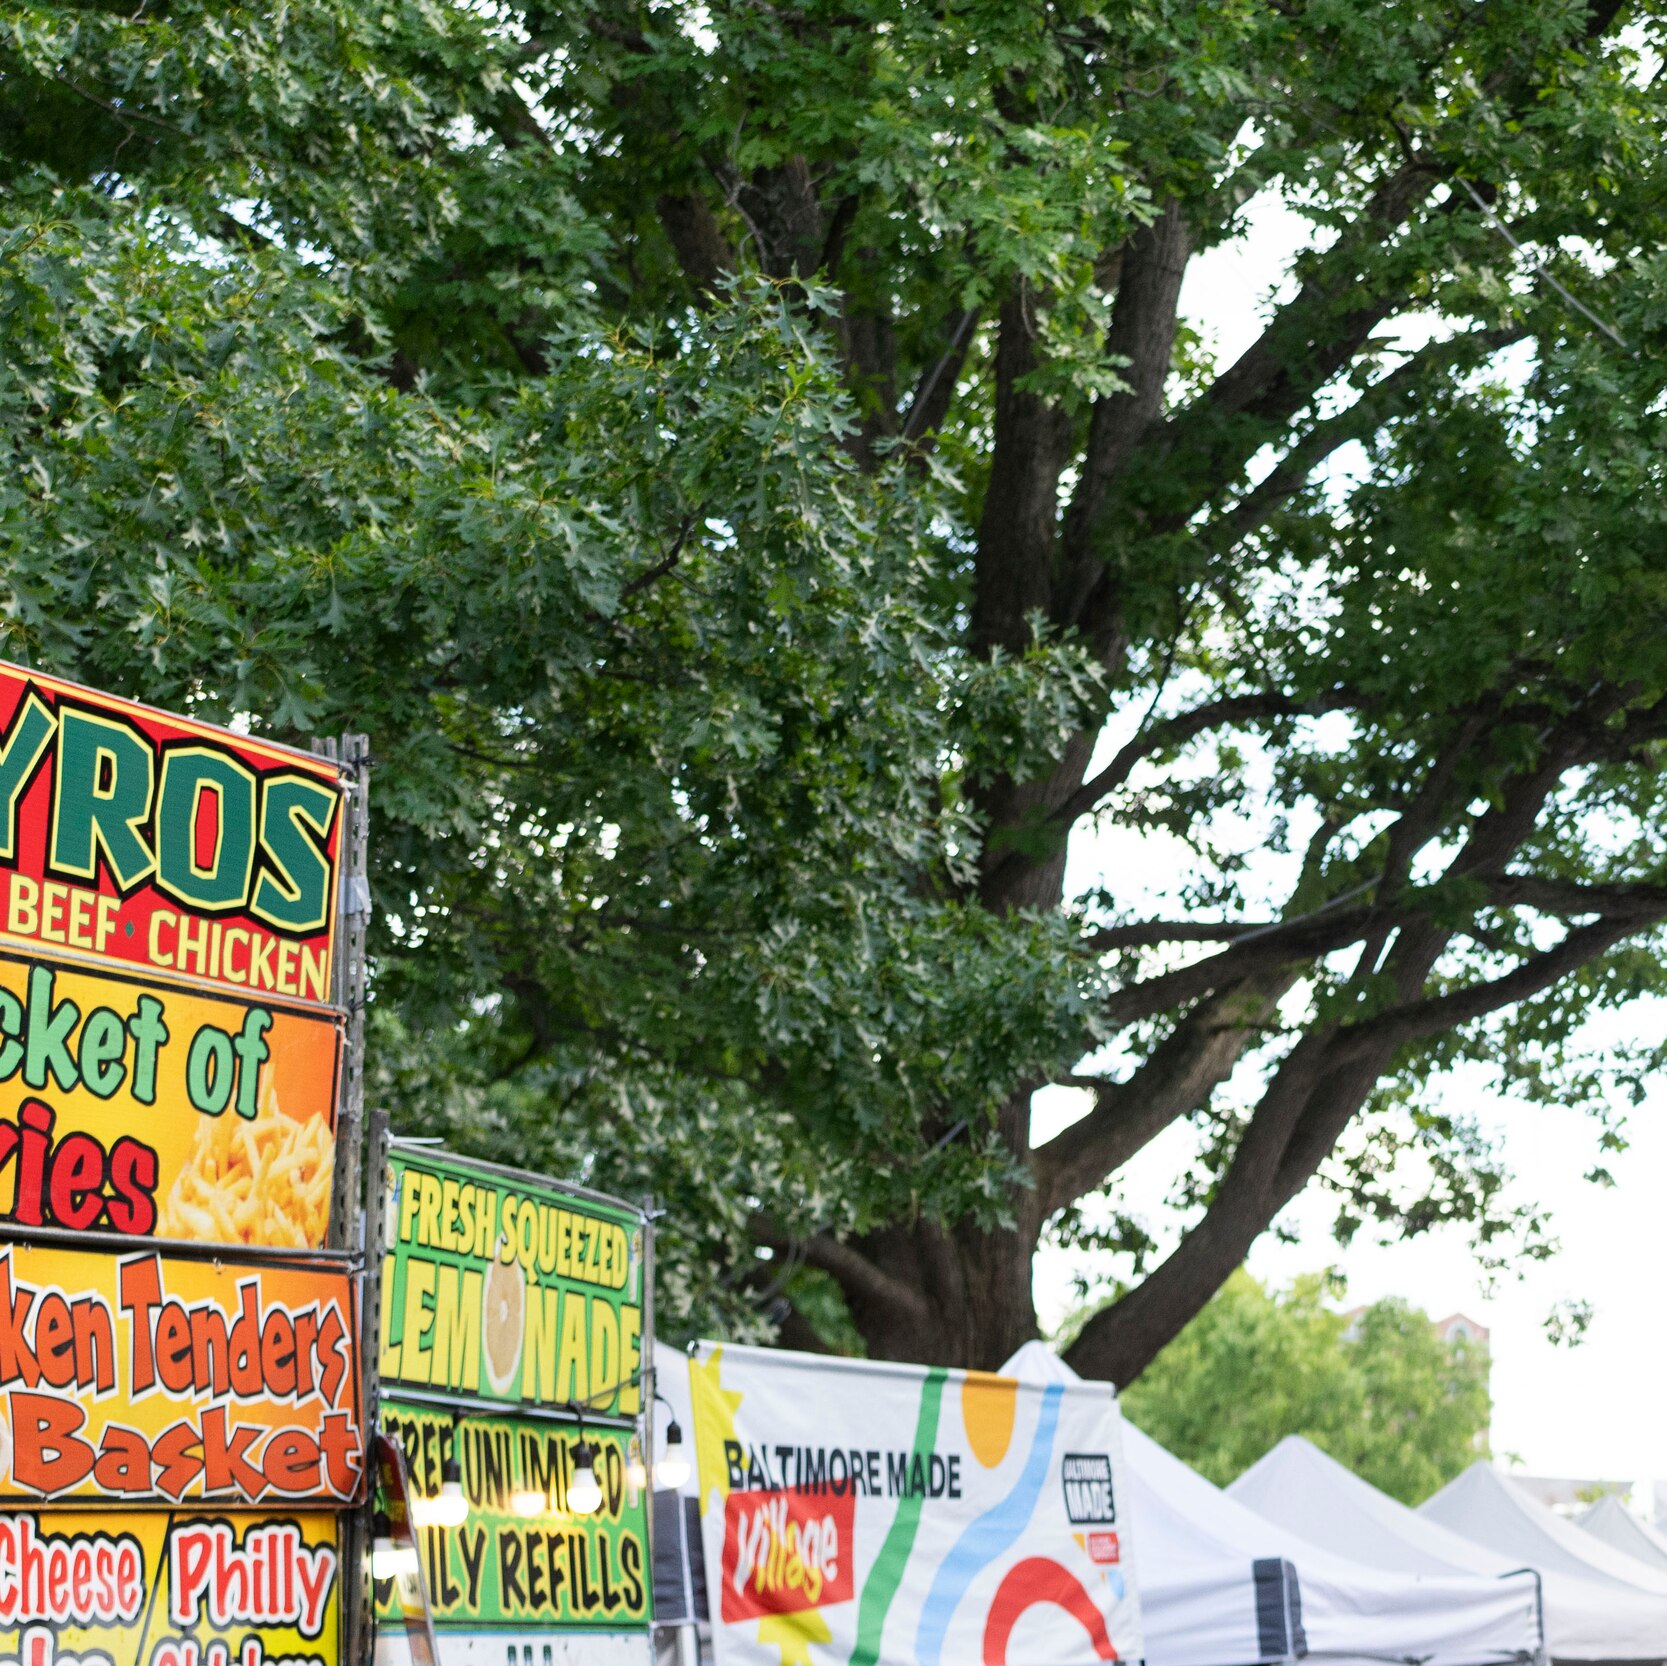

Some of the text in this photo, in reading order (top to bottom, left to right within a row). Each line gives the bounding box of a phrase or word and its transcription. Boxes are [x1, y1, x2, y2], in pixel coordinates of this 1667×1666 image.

[8, 873, 327, 1001] BEEF CHICKEN
[187, 1007, 273, 1120] of
[400, 1168, 629, 1290] FRESH SQUEEZED
[120, 1252, 346, 1410] Tenders
[10, 1391, 358, 1501] Basket
[724, 1439, 962, 1499] BALTIMORE MADE
[1065, 1481, 1114, 1520] MADE
[177, 1531, 331, 1629] Philly
[498, 1530, 643, 1611] REFILLS
[732, 1495, 839, 1605] Village
